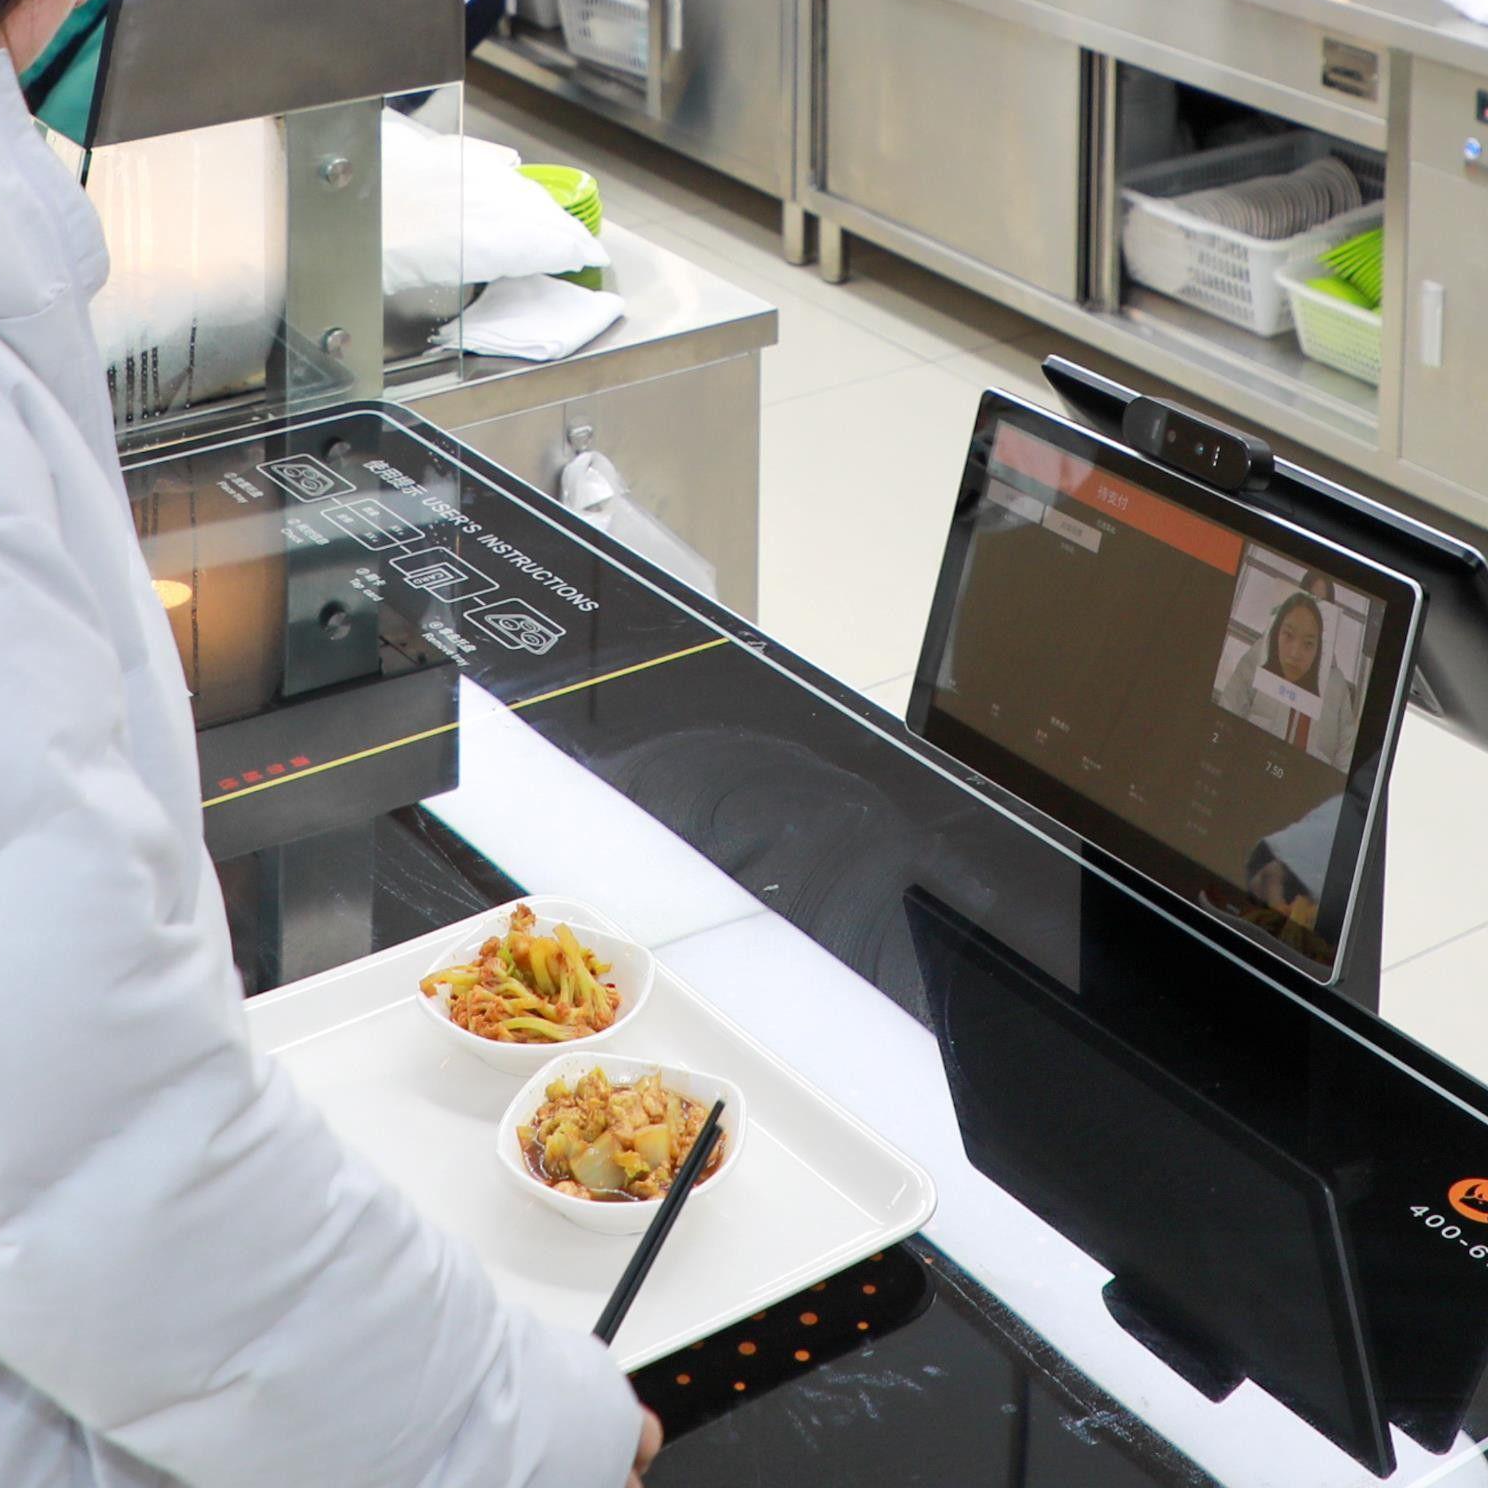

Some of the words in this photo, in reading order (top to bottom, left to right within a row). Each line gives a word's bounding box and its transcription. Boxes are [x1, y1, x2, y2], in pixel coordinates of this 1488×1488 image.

[363, 460, 428, 497] 使用提示
[422, 497, 482, 535] USER'S
[477, 533, 600, 612] INSTRUCTIONS
